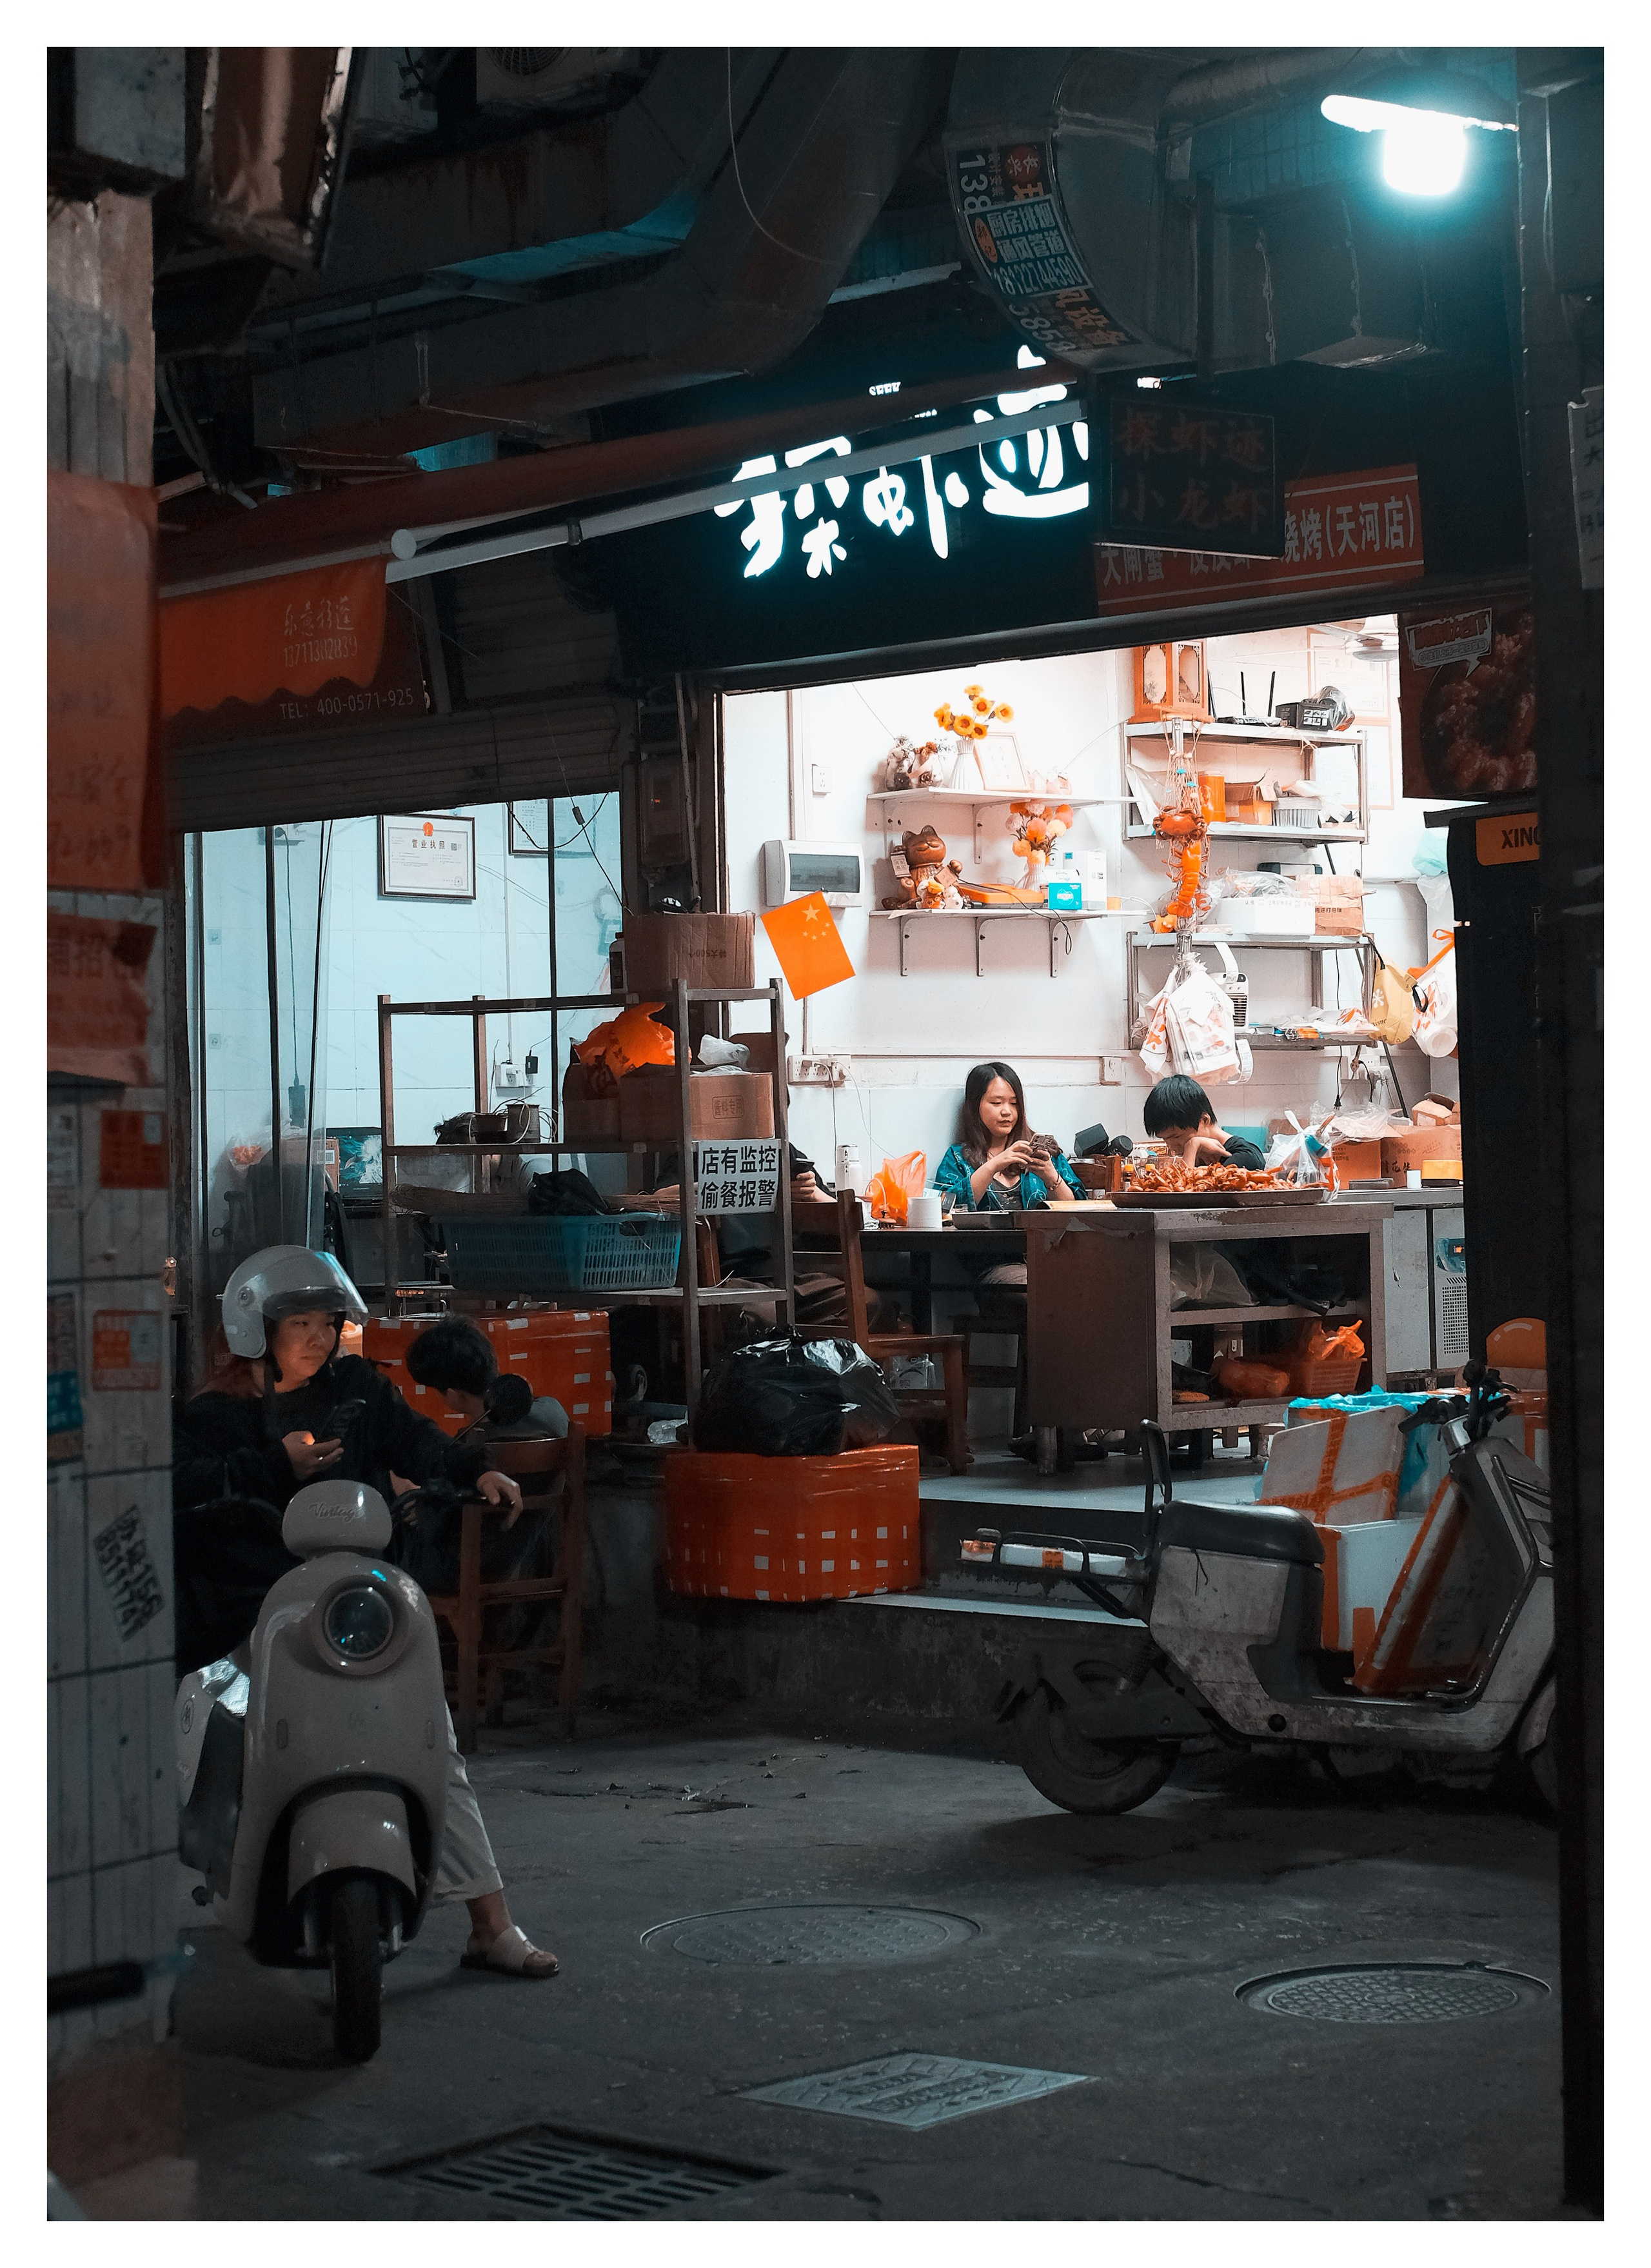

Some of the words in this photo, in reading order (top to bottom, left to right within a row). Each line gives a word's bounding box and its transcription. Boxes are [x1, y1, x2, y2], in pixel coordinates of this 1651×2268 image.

[987, 202, 1056, 238] 厨房排烟
[996, 230, 1067, 264] 通风管道
[1118, 408, 1269, 472] 探虾迹
[1119, 473, 1269, 533] 小龙虾
[279, 702, 309, 720] TEL:
[317, 687, 414, 715] 400-0571-925
[411, 839, 446, 850] 营业执照
[701, 1145, 776, 1175] 店有监控
[701, 1179, 776, 1209] 偷餐报警
